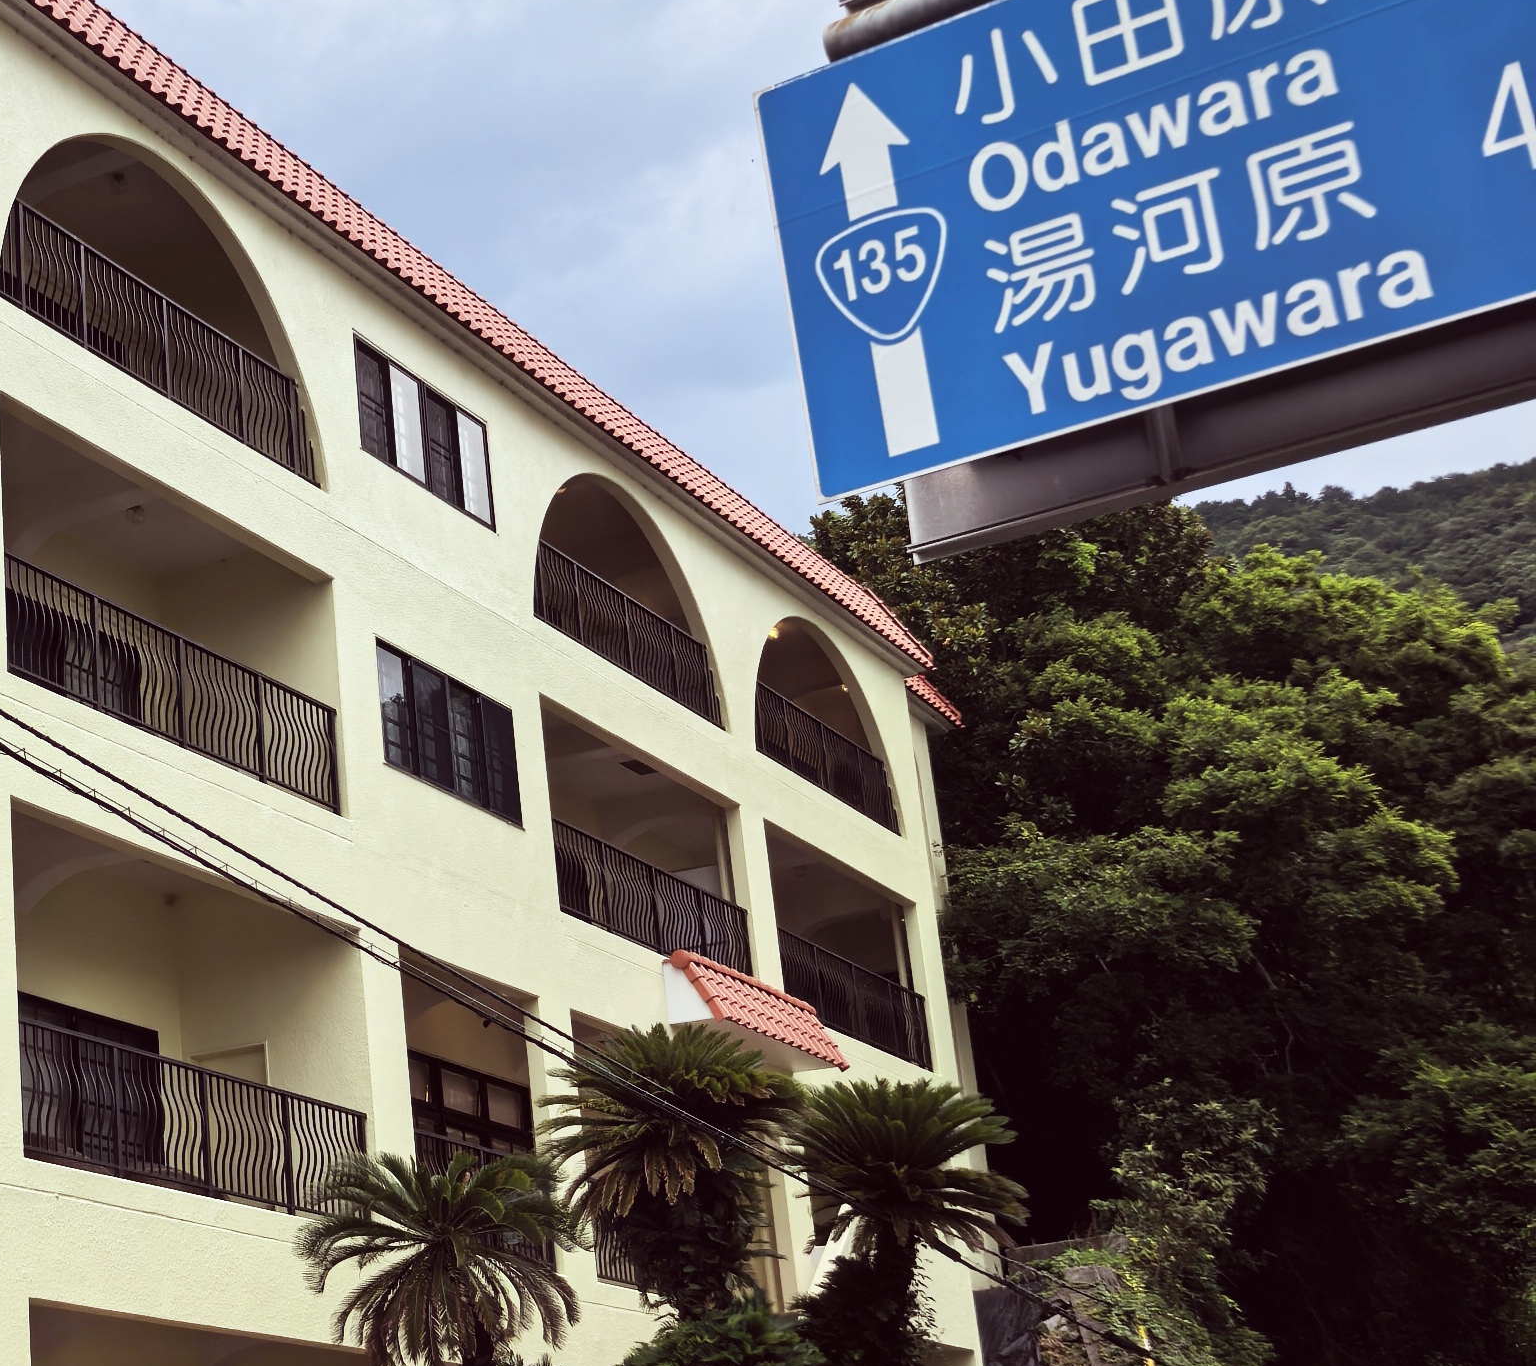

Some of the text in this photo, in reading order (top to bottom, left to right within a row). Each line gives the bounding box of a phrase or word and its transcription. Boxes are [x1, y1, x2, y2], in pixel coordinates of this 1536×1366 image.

[967, 48, 1340, 212] Odawara
[832, 224, 928, 303] 135
[984, 120, 1377, 335] 湯河原
[1002, 248, 1435, 416] Yugawara
